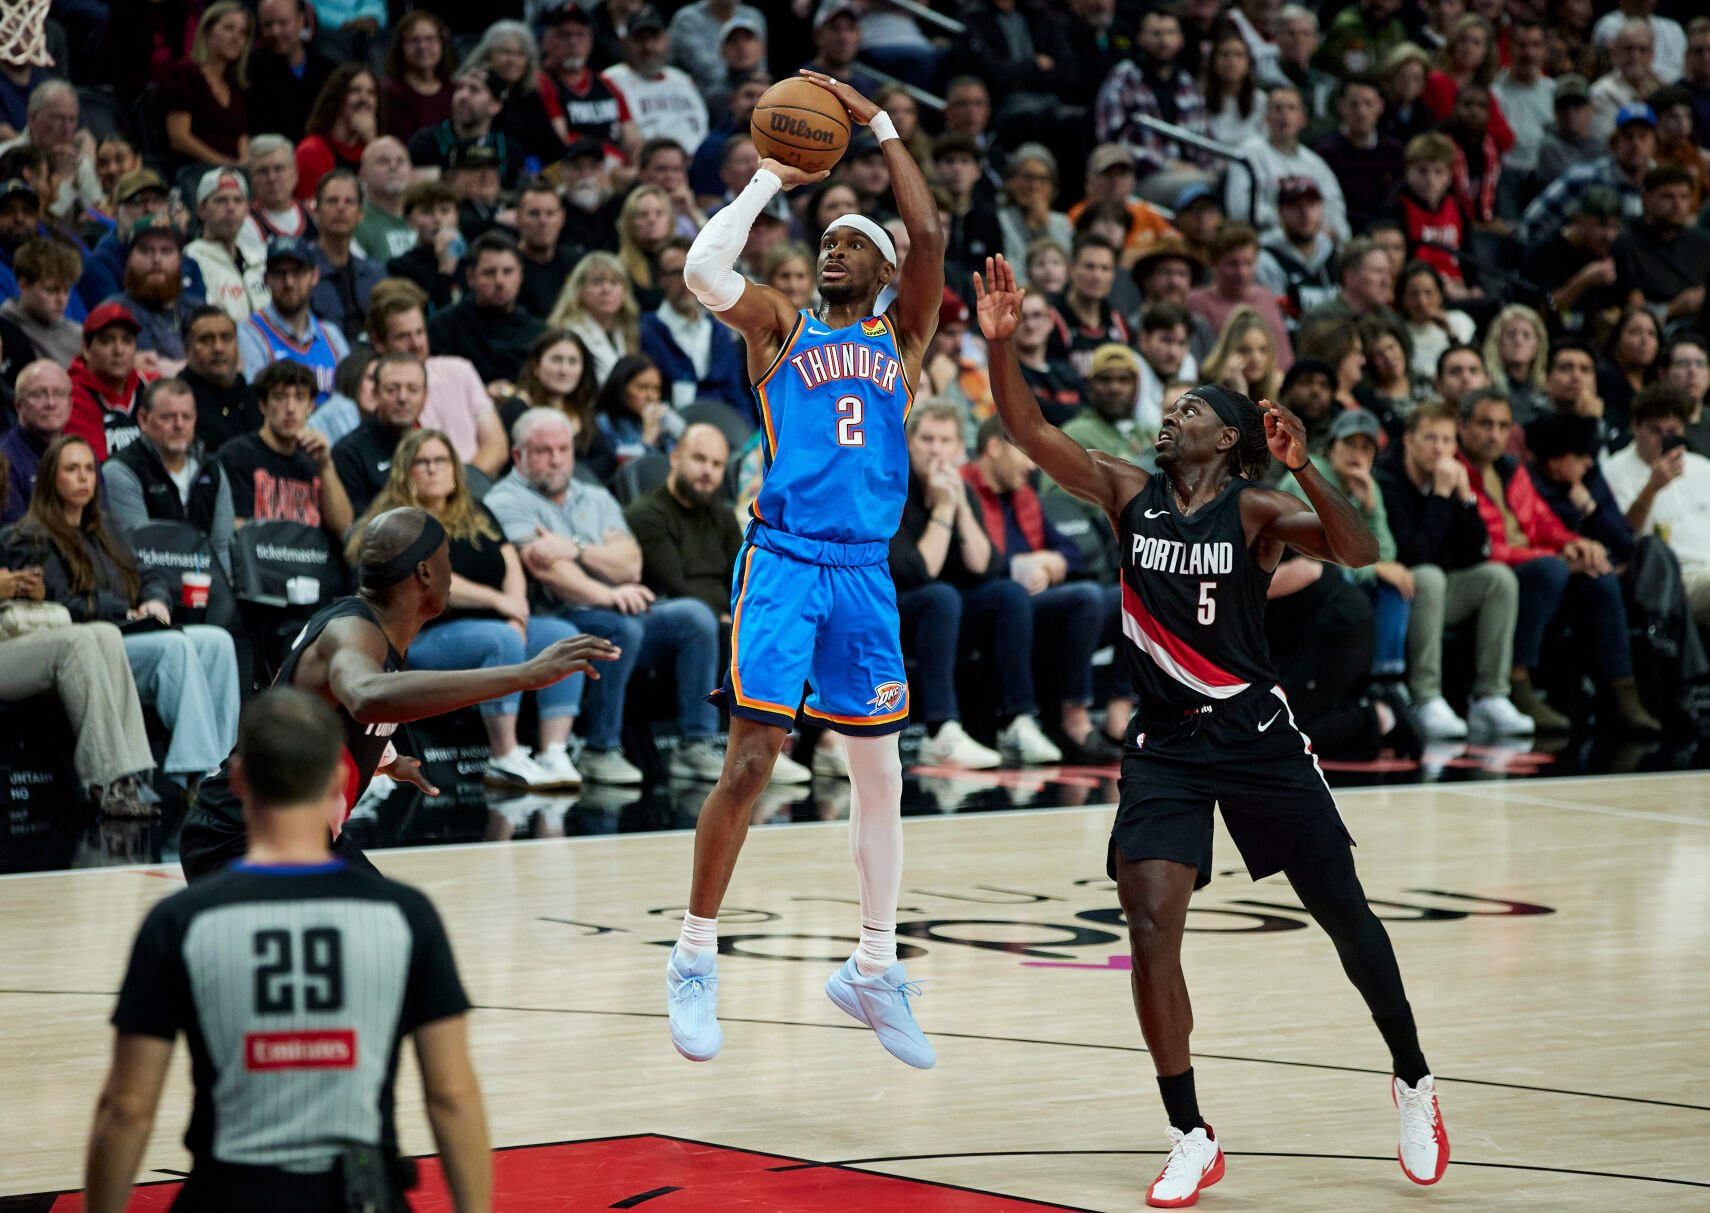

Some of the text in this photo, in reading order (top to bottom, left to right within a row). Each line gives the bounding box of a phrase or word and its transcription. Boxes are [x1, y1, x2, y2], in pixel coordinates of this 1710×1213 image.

[769, 111, 835, 145] Wilson
[790, 342, 900, 393] THUNDER
[836, 394, 865, 446] 2
[257, 543, 329, 565] ticketmaster
[1132, 532, 1234, 575] PORTLAND
[1197, 581, 1217, 625] 5
[876, 686, 900, 708] OKC
[253, 927, 345, 1014] 29
